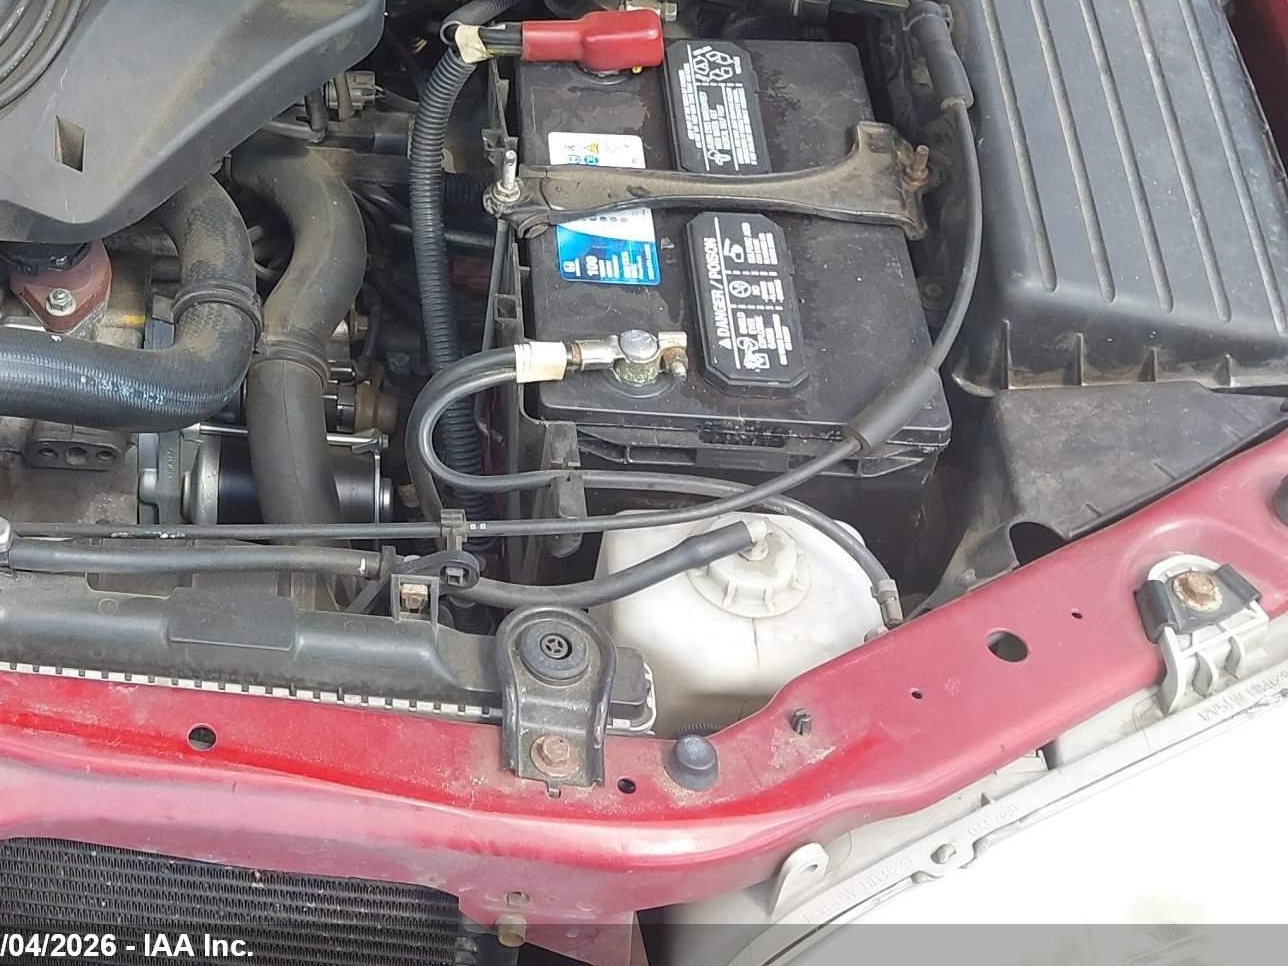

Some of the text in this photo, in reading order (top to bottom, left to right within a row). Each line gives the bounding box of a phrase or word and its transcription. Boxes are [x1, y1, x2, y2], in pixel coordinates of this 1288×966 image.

[585, 254, 599, 277] 100
[703, 237, 722, 279] POISON
[710, 289, 731, 338] DANGER
